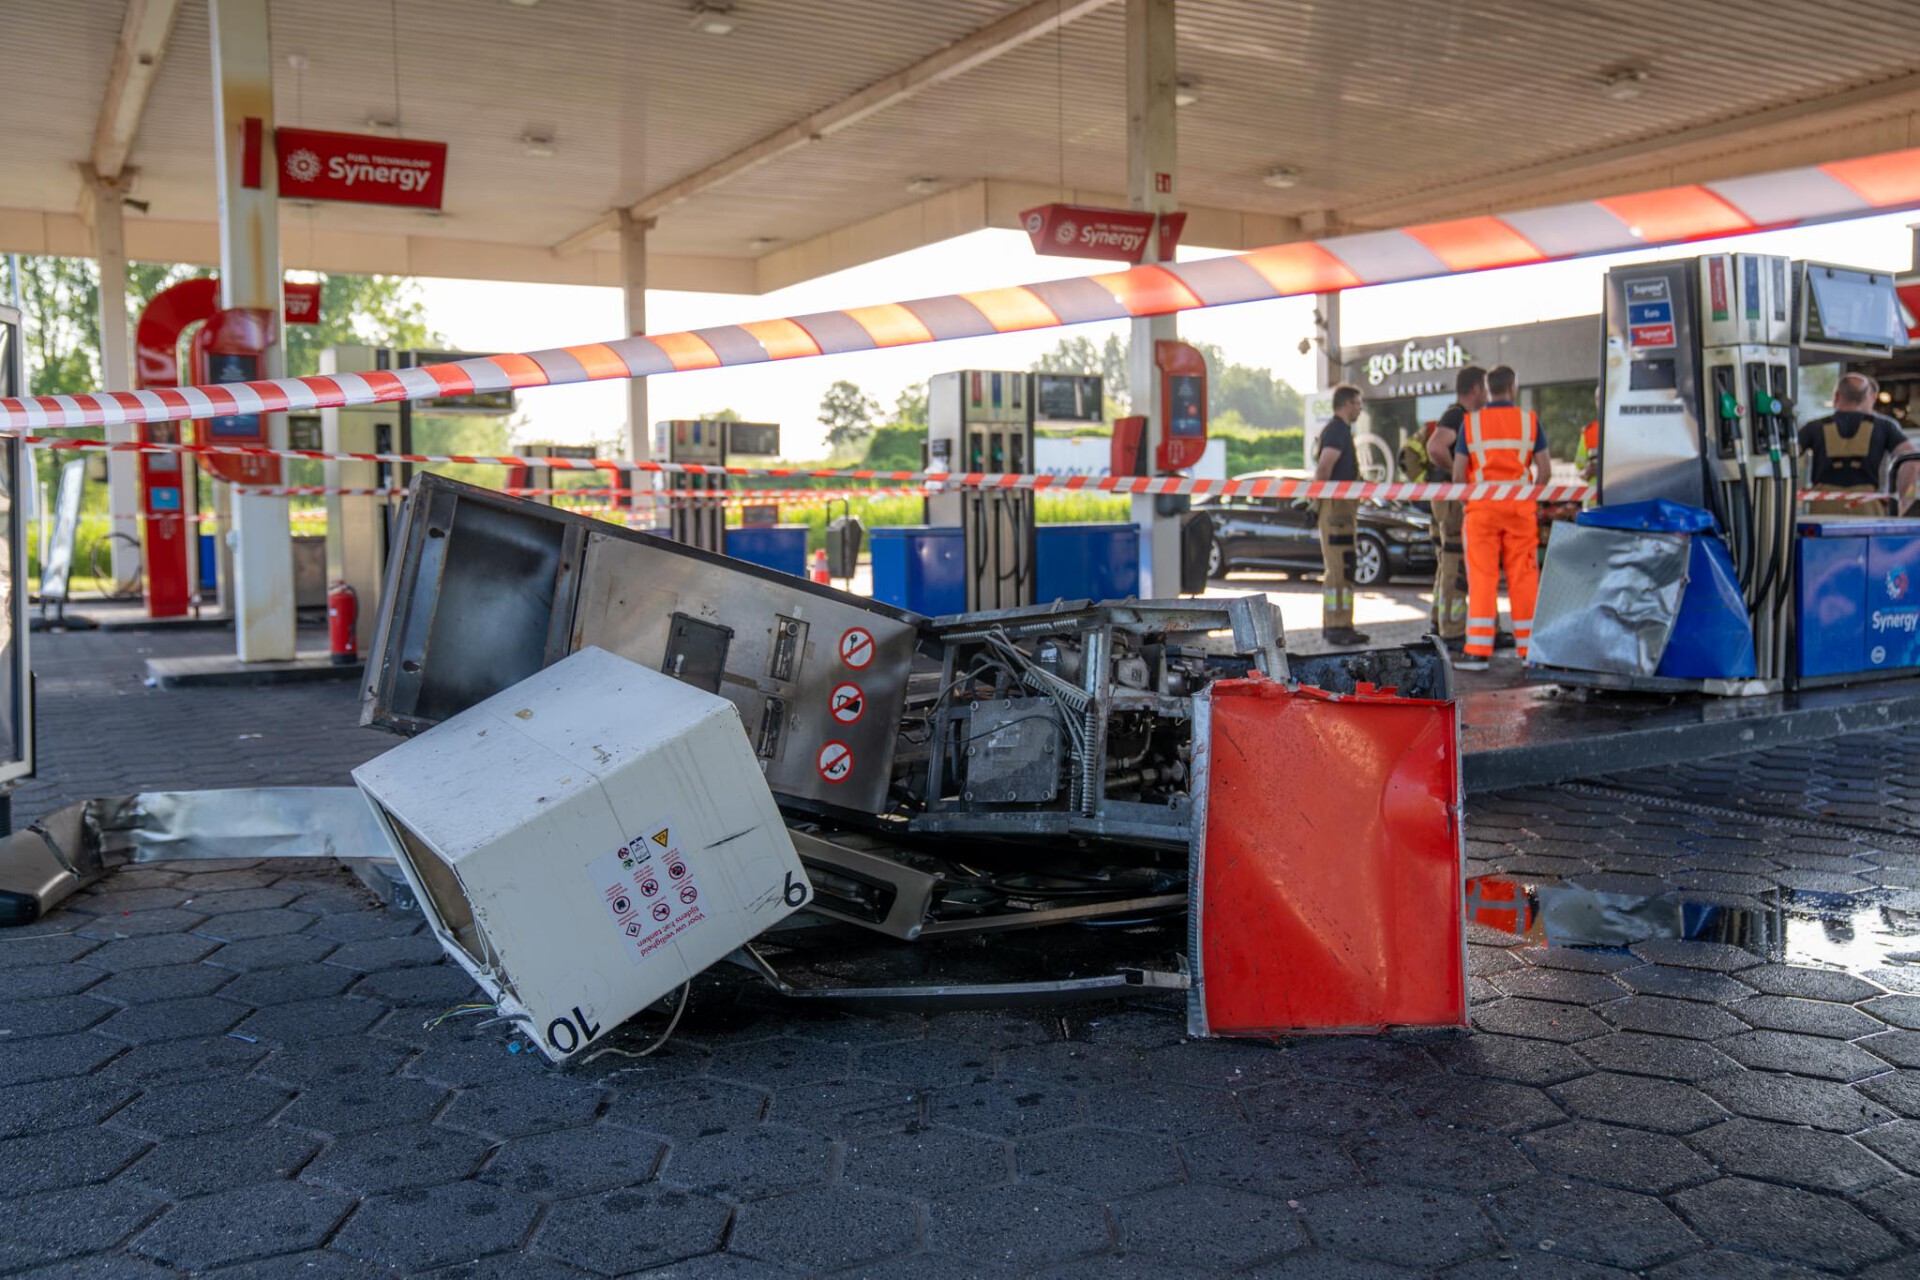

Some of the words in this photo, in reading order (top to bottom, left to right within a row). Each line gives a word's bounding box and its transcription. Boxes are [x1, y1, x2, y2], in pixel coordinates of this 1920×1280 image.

[328, 156, 431, 192] Synergy
[1080, 226, 1144, 251] Synergy
[1644, 307, 1660, 319] Euro
[1368, 353, 1397, 386] go
[1402, 336, 1463, 373] fresh
[1388, 381, 1442, 397] BAKERY
[1872, 610, 1919, 634] Synergy
[675, 906, 700, 925] tijdens
[687, 912, 705, 926] Voor
[637, 929, 663, 948] tanken
[675, 923, 687, 934] uw
[640, 932, 675, 957] veiligheid
[548, 1005, 600, 1053] 10
